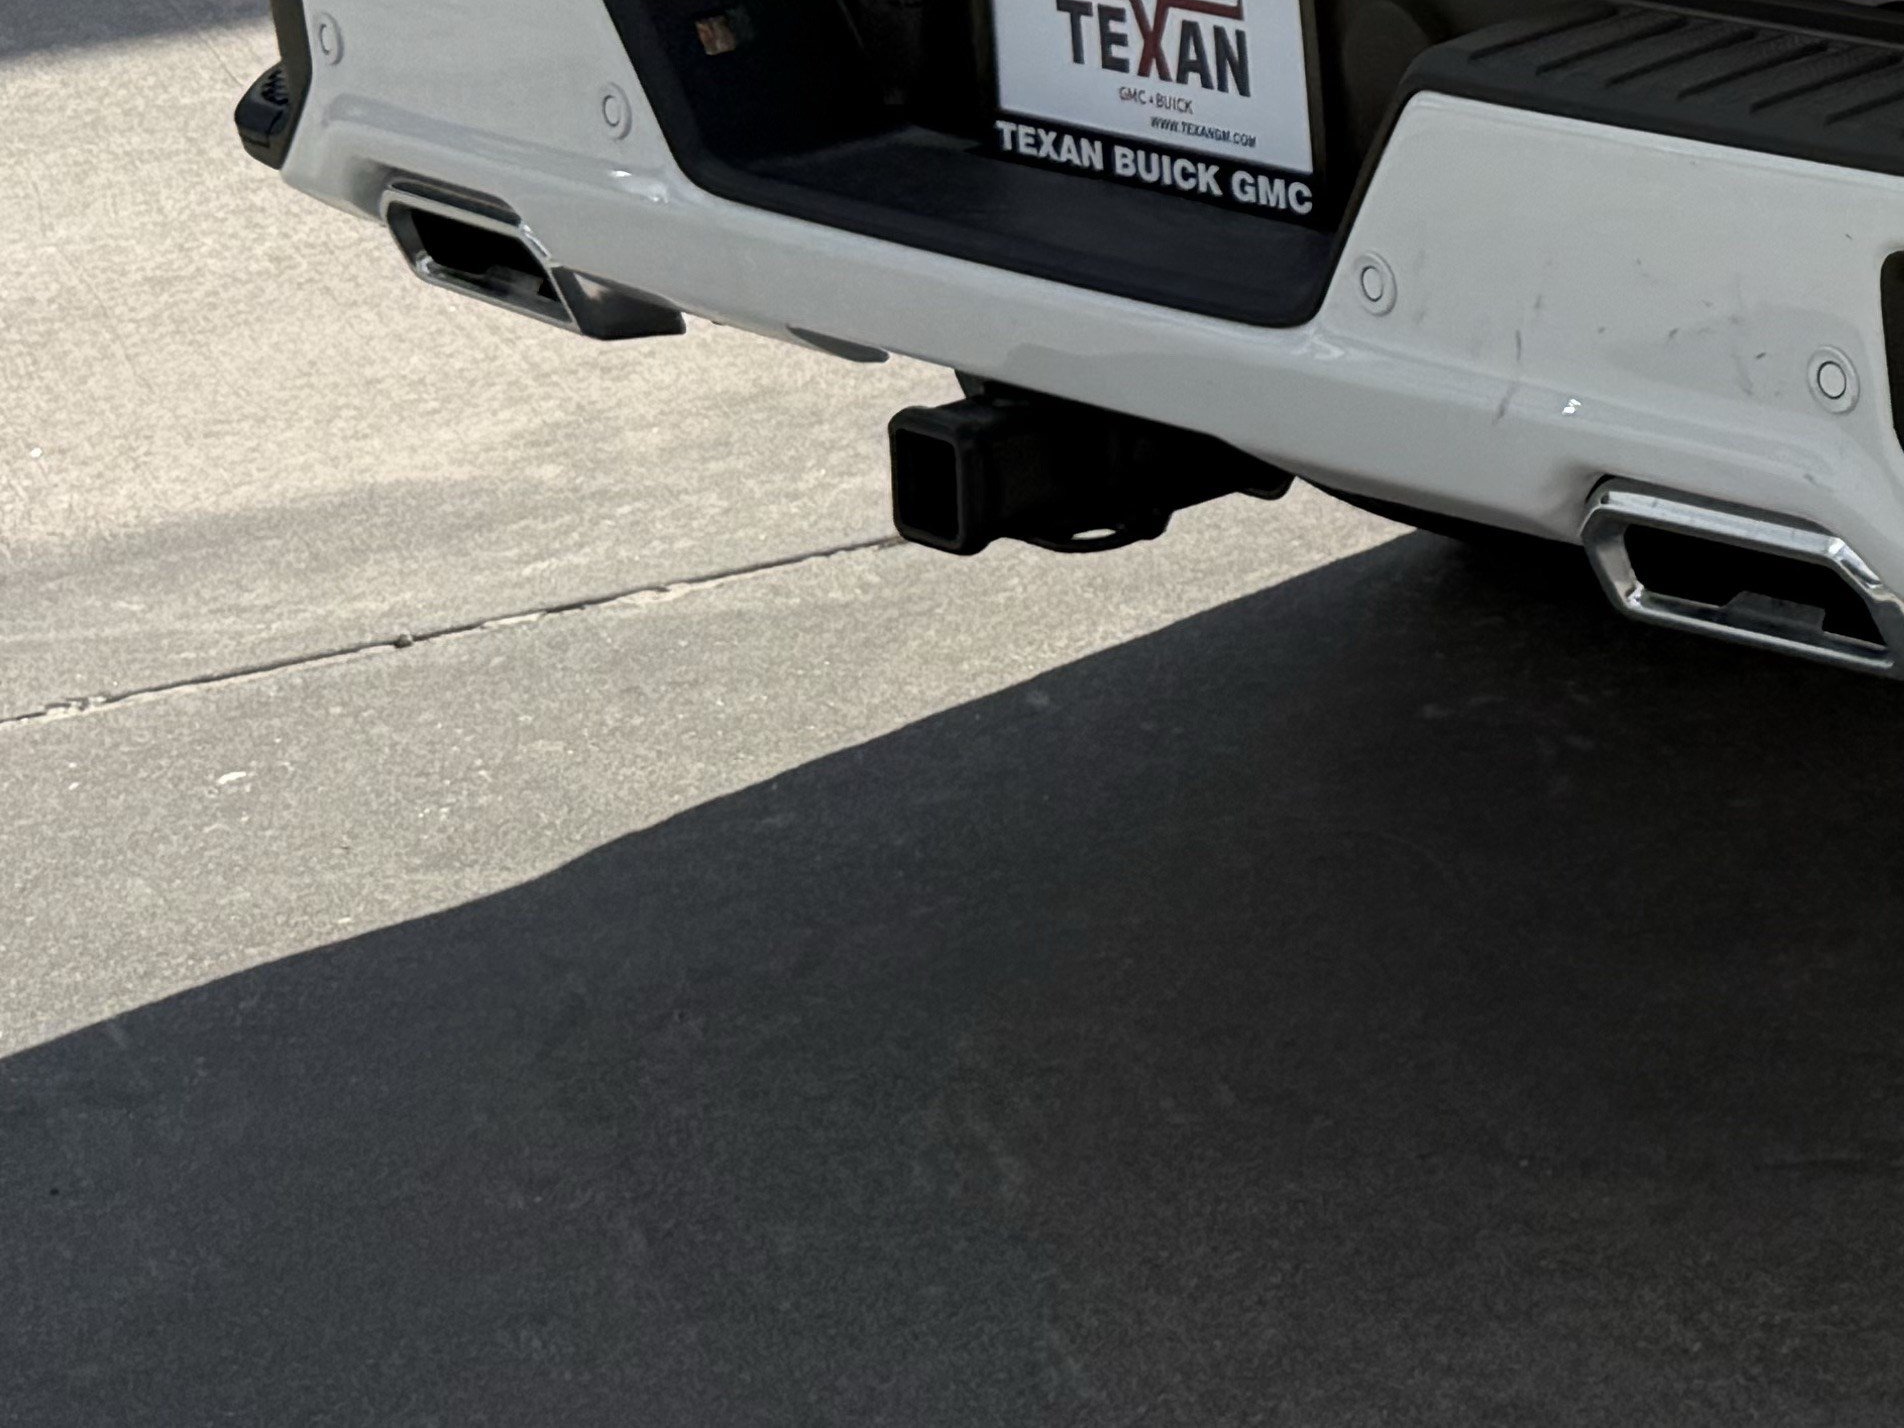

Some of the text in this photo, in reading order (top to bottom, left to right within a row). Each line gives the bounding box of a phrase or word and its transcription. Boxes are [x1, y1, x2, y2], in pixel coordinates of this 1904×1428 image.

[1118, 85, 1194, 115] GMC BUICK
[1149, 115, 1257, 148] WWW.TEXANGM.COM
[995, 119, 1314, 215] TEXAN BUICK GMC
